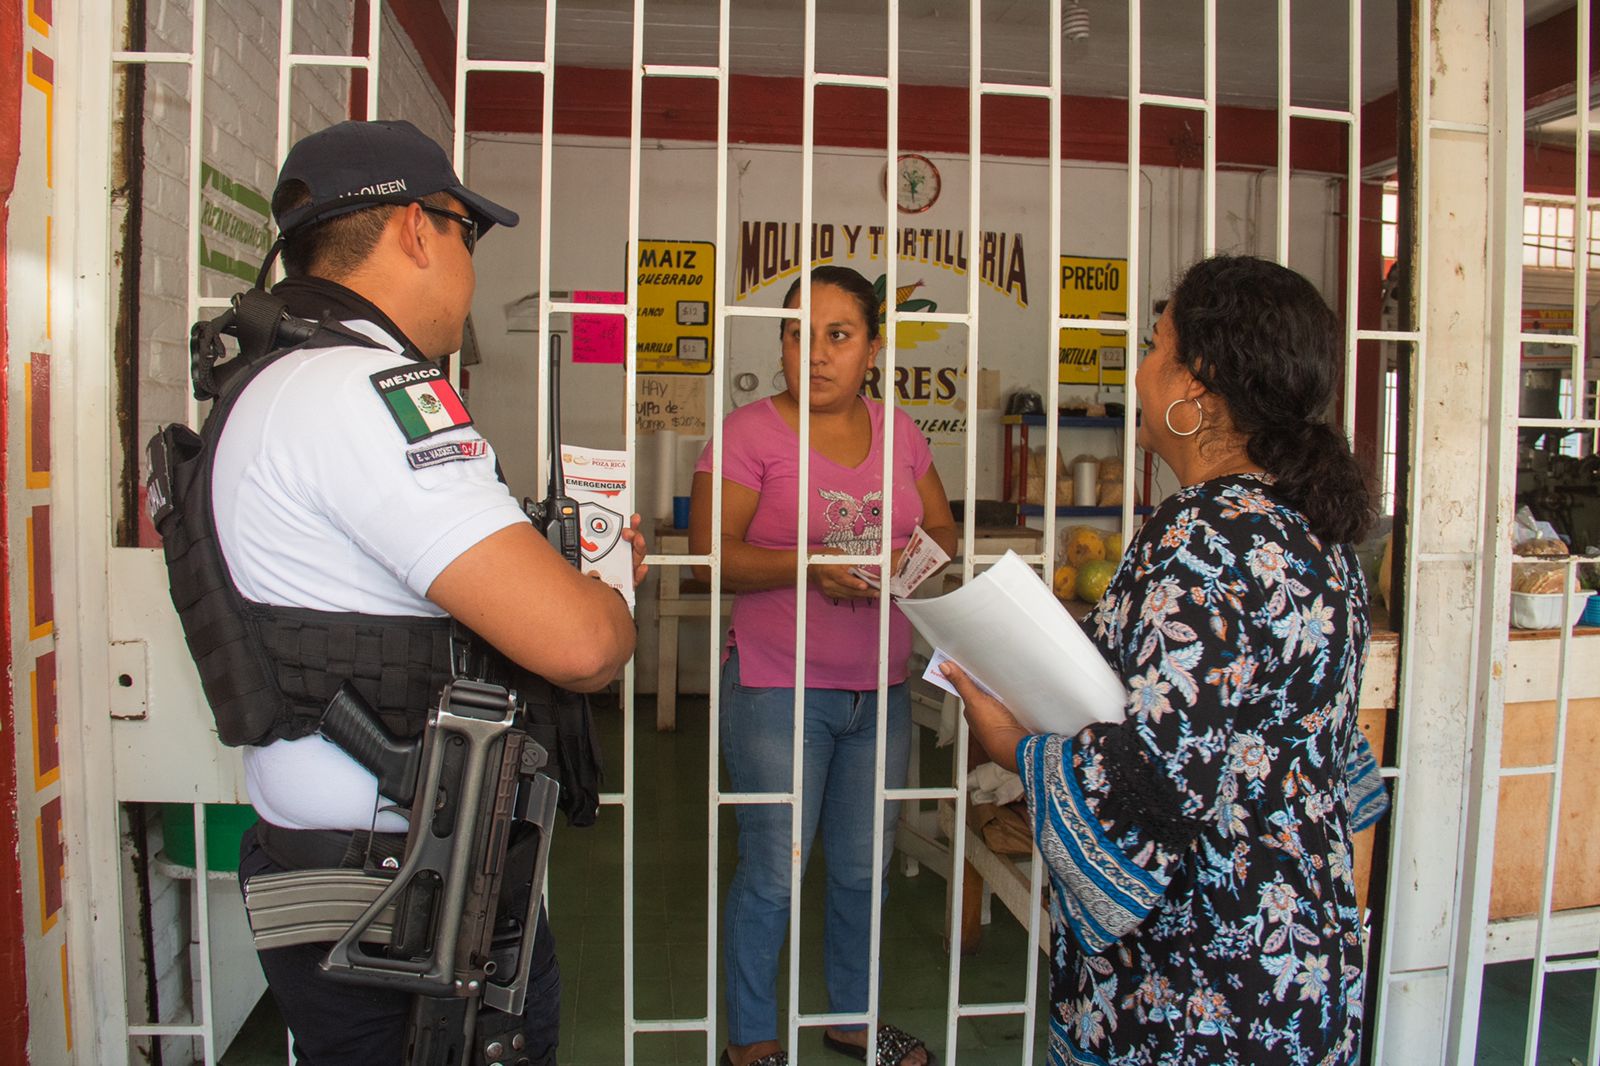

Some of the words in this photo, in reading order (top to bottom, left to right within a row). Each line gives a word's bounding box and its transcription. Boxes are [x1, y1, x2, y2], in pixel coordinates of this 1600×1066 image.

[339, 178, 407, 198] QUEEN
[639, 249, 697, 269] MAIZ
[841, 224, 862, 259] Y
[867, 225, 1029, 309] TRTILLRIA
[637, 273, 704, 287] QUEBRADO
[637, 307, 665, 318] LANCO
[636, 342, 673, 354] MARILLO
[1059, 347, 1098, 366] ORTILLA
[641, 379, 668, 398] HAY
[914, 417, 967, 432] IENE!
[565, 478, 627, 490] EMERGENCIAS
